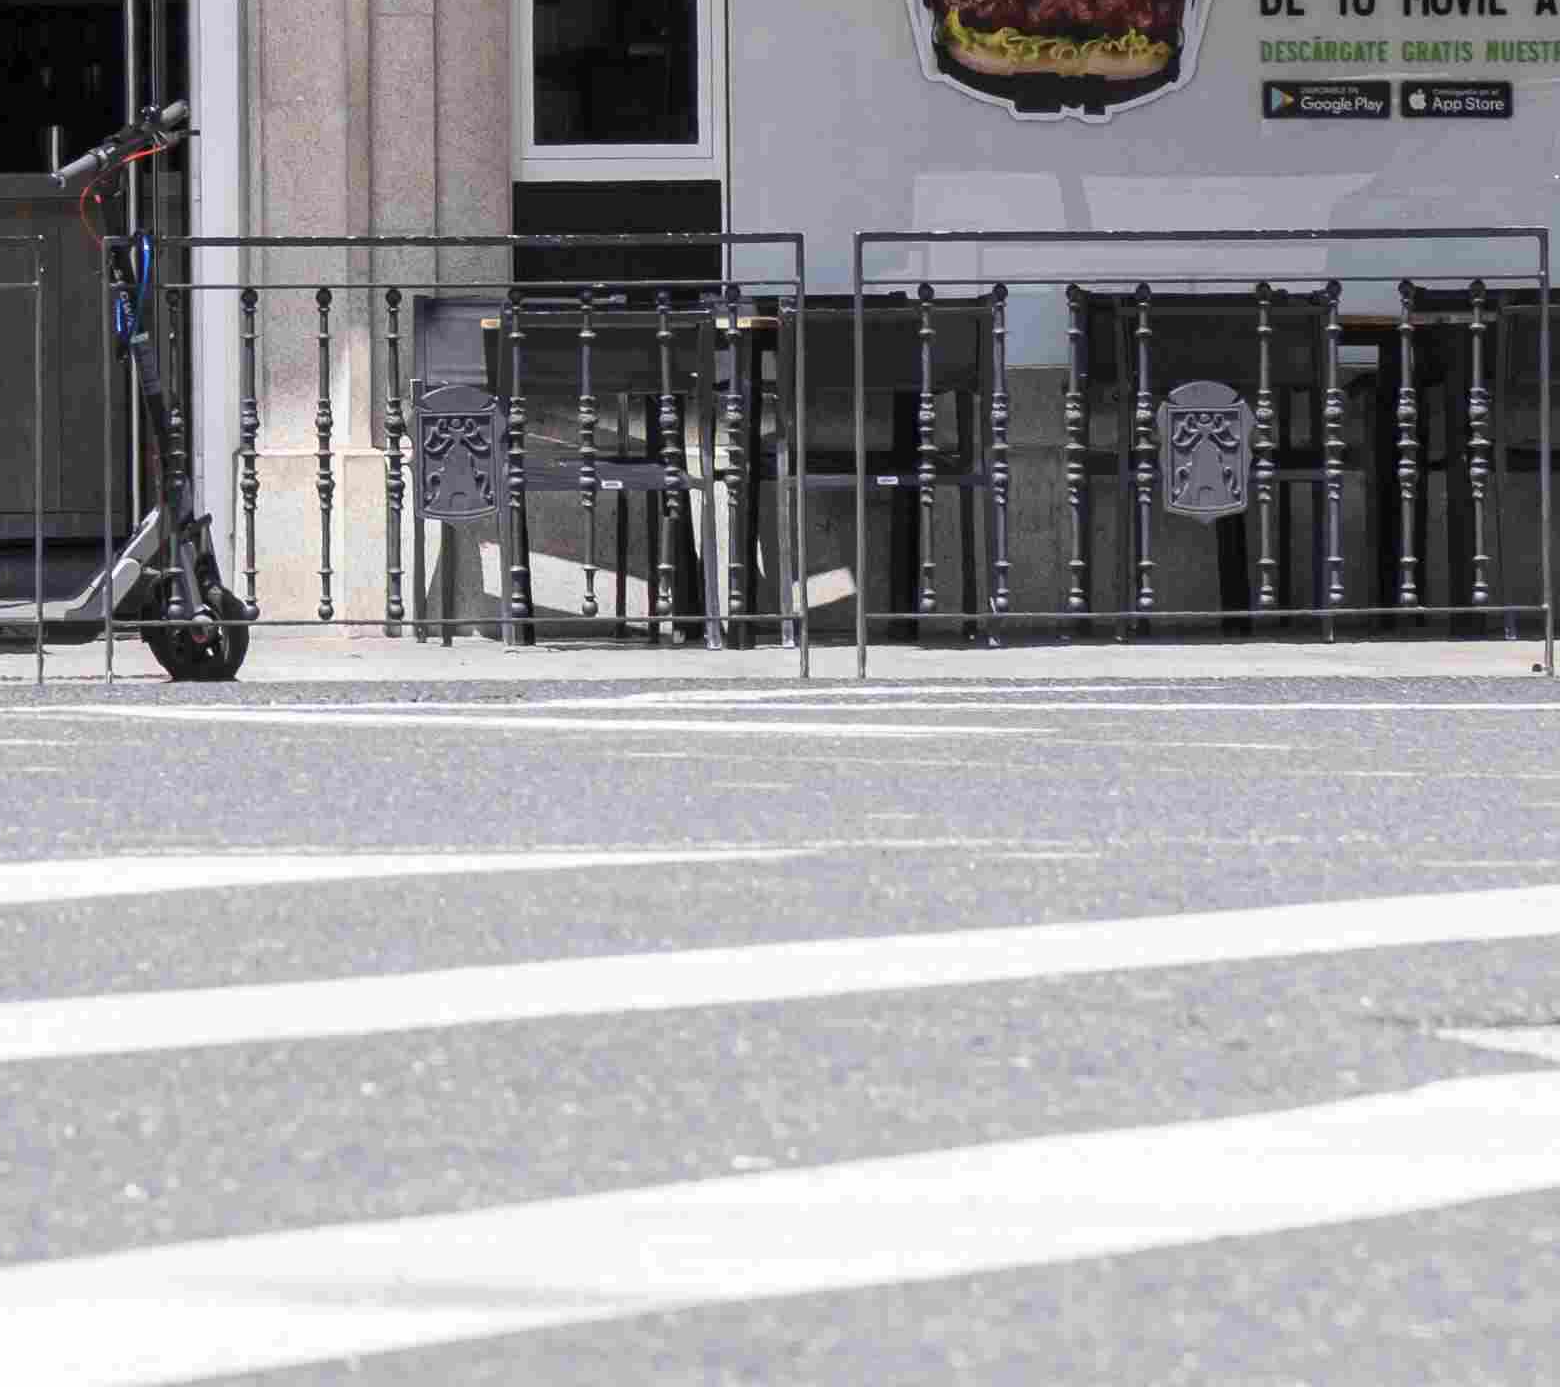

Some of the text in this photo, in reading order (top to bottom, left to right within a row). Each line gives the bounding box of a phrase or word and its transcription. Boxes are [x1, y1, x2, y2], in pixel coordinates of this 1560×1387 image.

[1260, 36, 1389, 63] DESCÁRGATE
[1401, 40, 1474, 63] GRATIS
[1300, 96, 1384, 114] Google Play
[1431, 96, 1505, 113] App Store
